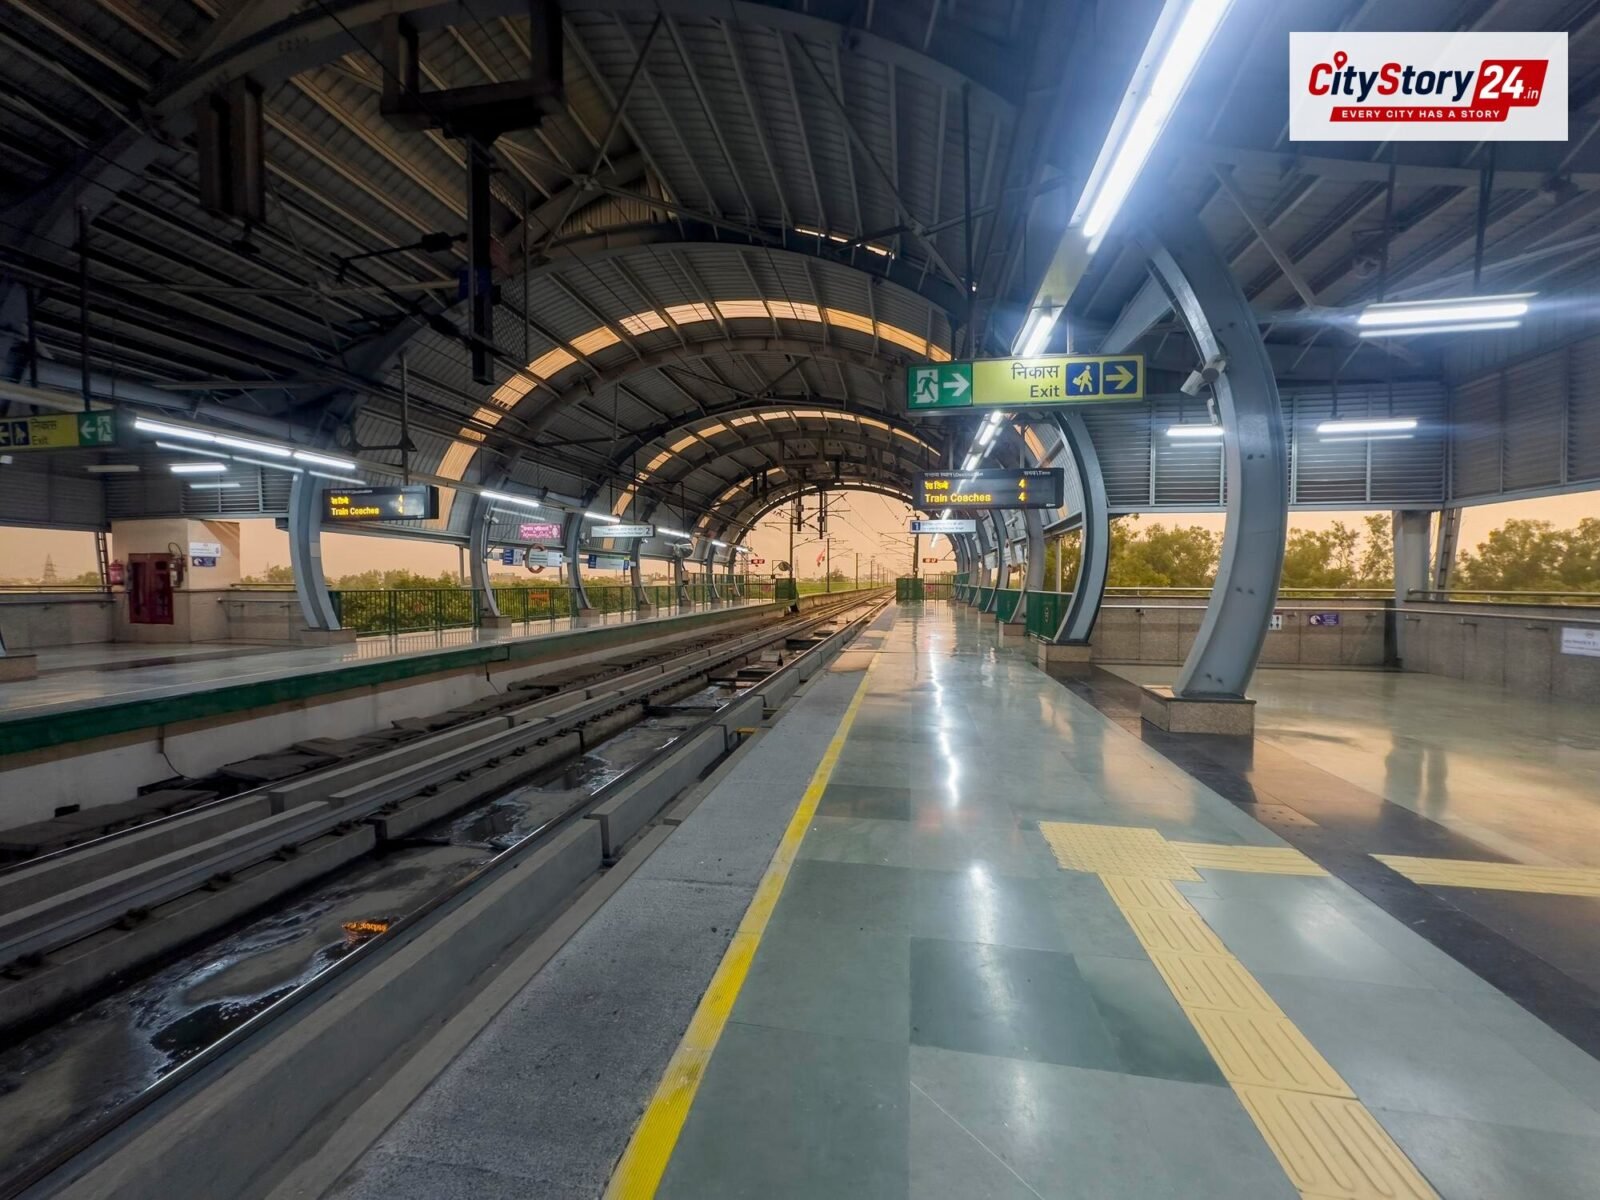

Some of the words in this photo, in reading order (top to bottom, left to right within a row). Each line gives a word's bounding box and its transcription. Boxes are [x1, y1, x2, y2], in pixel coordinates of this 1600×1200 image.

[1010, 362, 1061, 380] निकास
[1030, 385, 1060, 398] Exit
[31, 435, 49, 446] Exit
[1018, 479, 1026, 488] 4
[925, 493, 948, 503] Train
[950, 493, 992, 502] Coaches
[1018, 492, 1026, 501] 4
[331, 507, 349, 516] Train
[349, 507, 380, 515] Coaches
